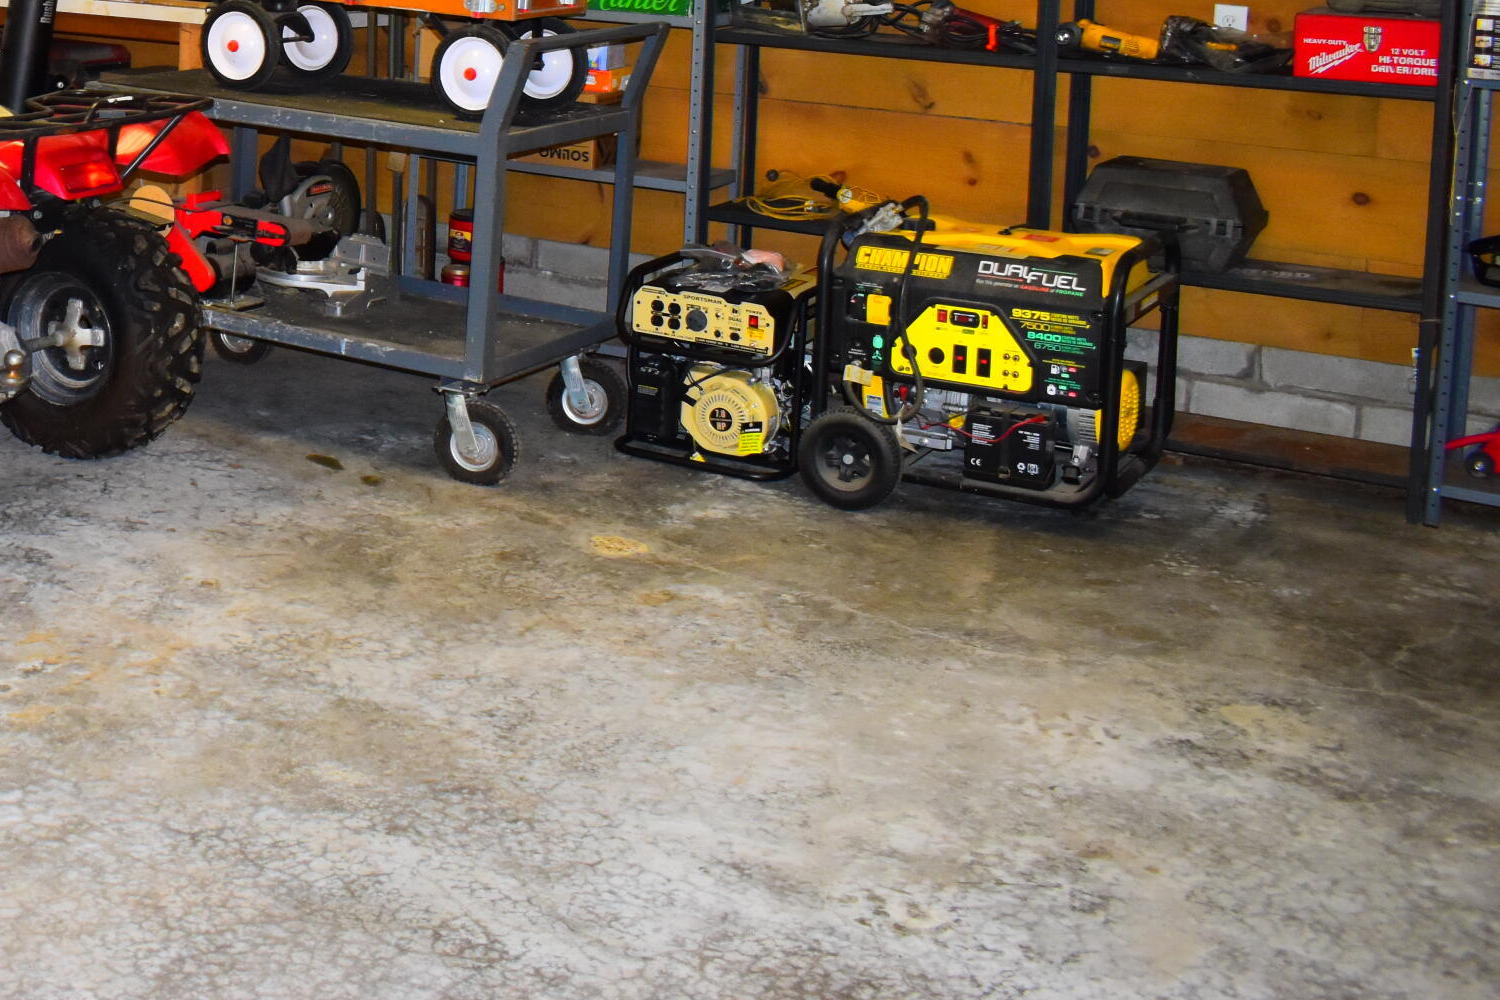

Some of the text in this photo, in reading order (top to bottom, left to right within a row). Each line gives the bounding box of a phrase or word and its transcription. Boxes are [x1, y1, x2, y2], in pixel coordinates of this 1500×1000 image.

[1379, 56, 1437, 67] HI-TORQUE
[1371, 64, 1438, 77] DRIVER/DRIL
[856, 246, 955, 274] CHAMION
[1011, 308, 1051, 321] 9375
[1020, 321, 1051, 331] 7500
[1027, 331, 1062, 342] 8400
